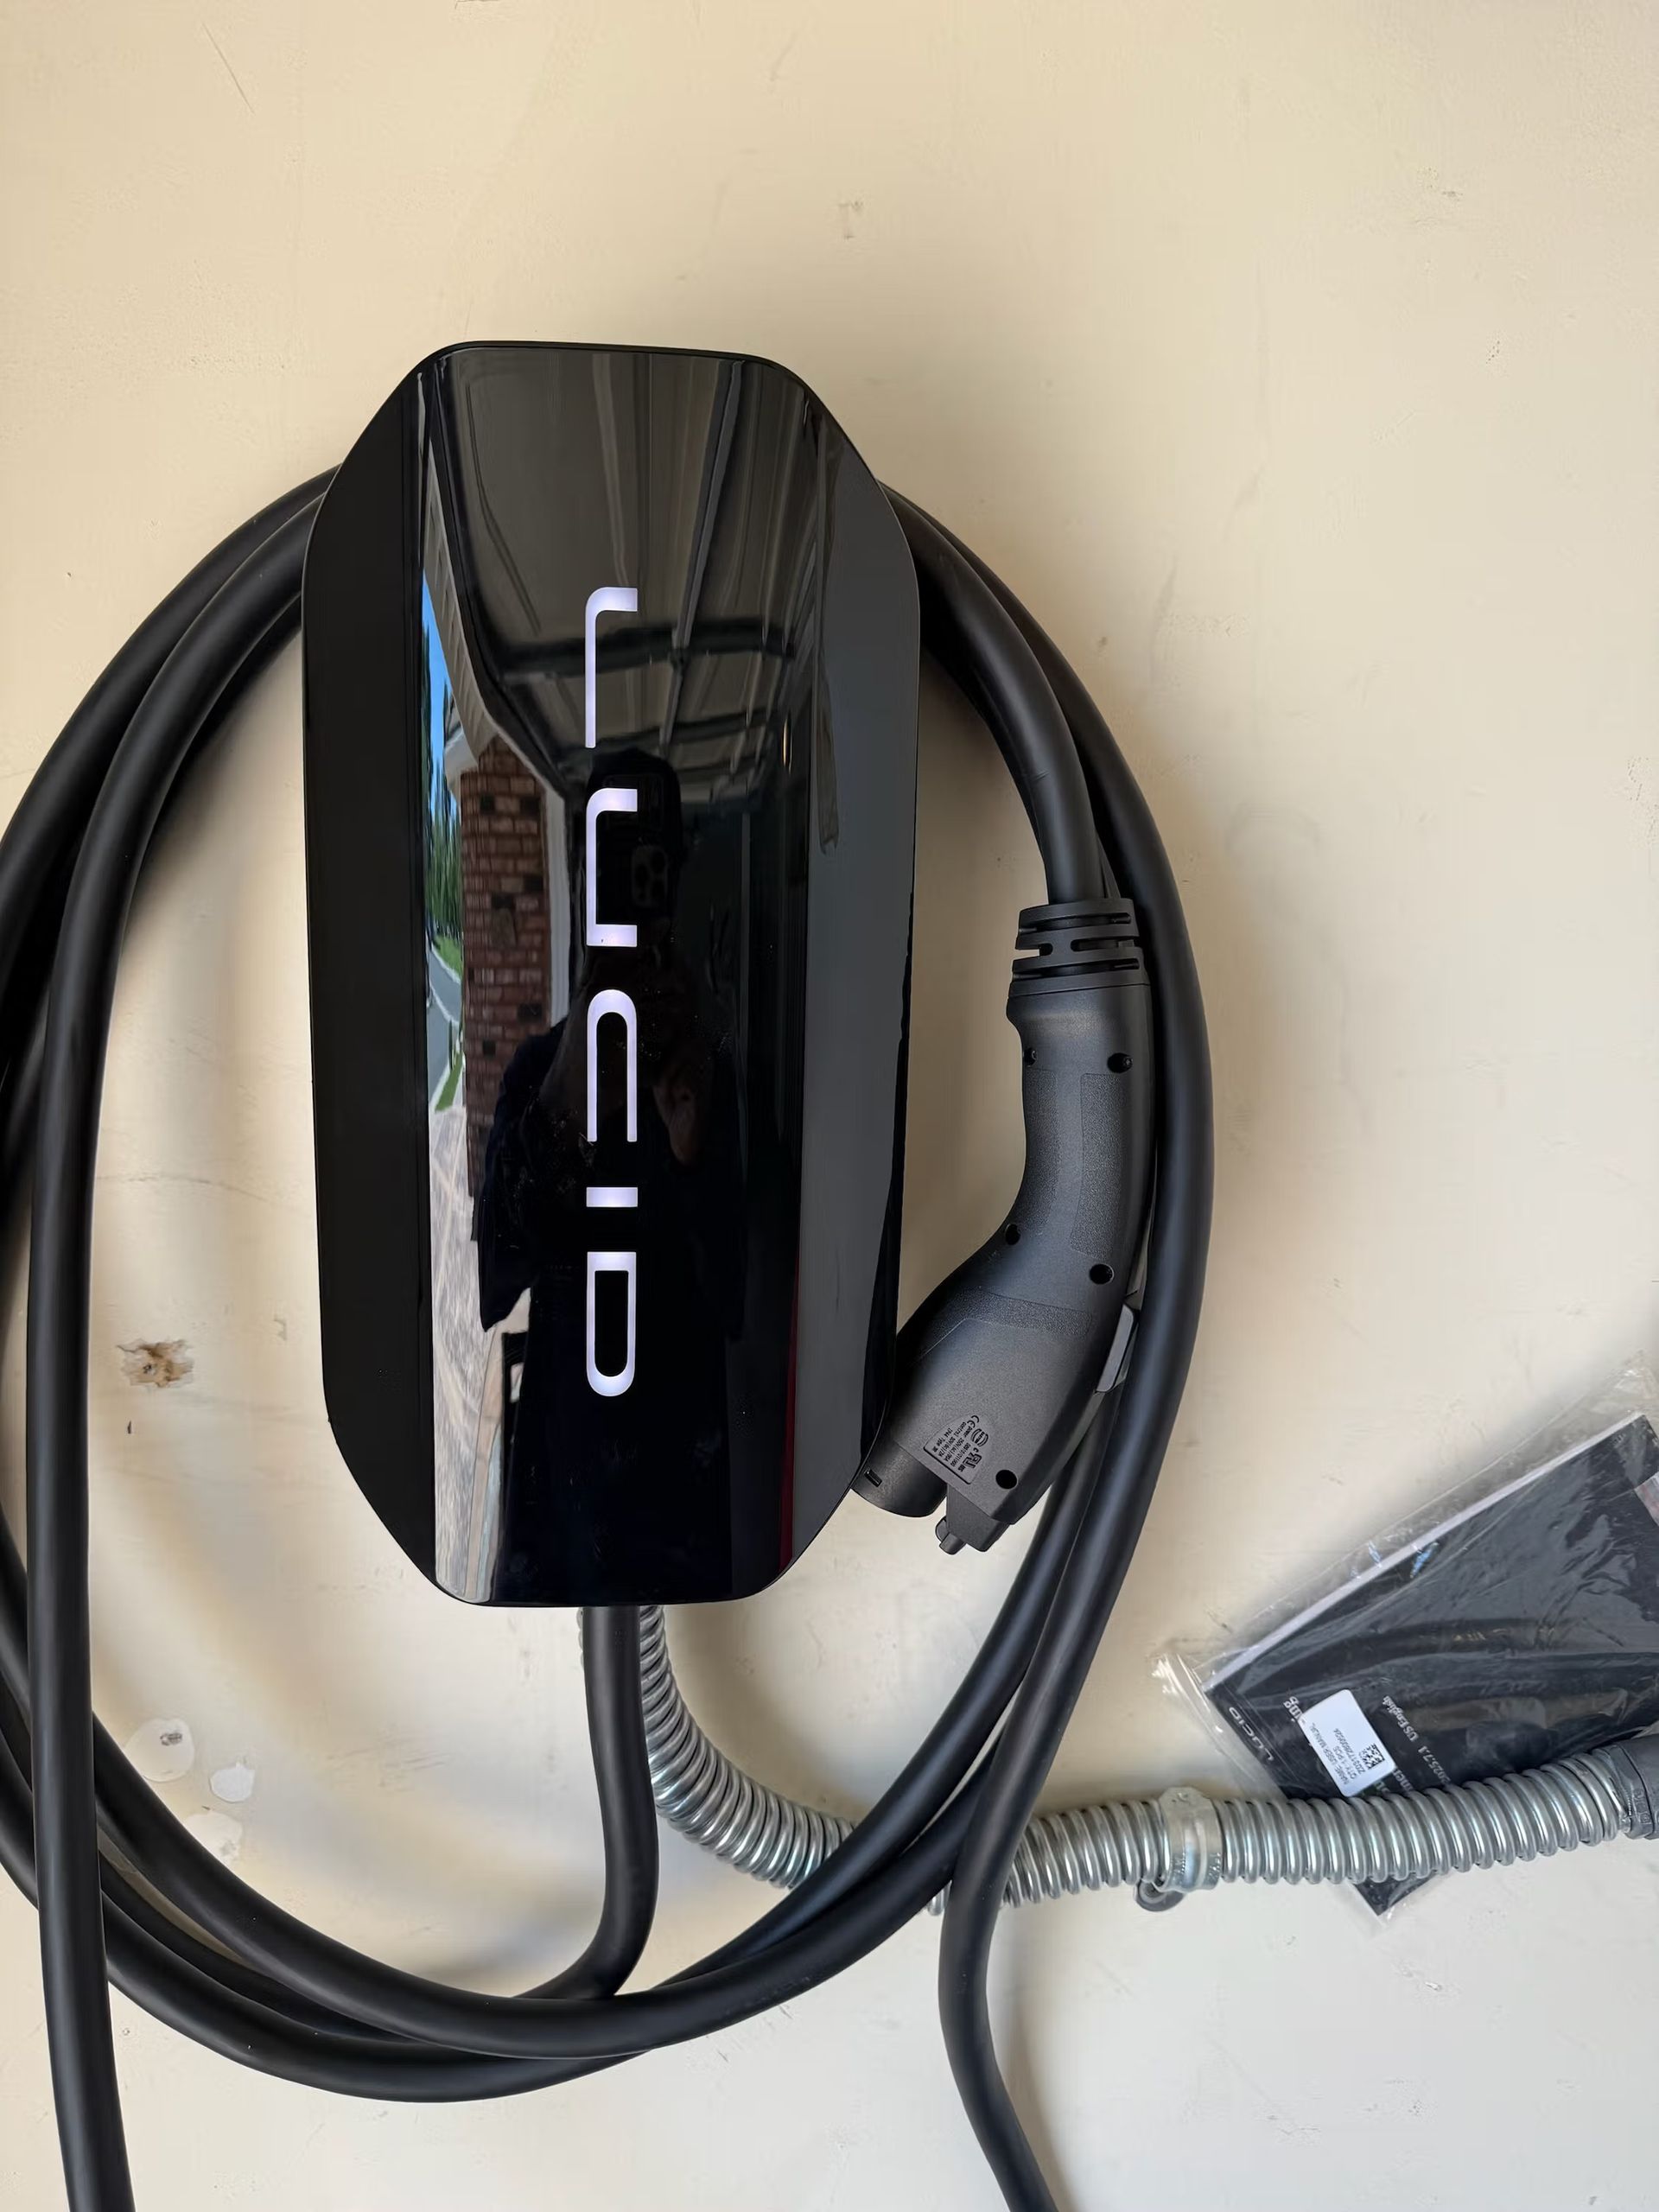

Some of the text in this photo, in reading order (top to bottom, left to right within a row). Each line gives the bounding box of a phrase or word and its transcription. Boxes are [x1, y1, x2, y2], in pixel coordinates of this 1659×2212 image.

[584, 587, 639, 1397] LUCID
[1382, 1695, 1410, 1728] English
[1229, 1707, 1274, 1761] LUCID
[1403, 1726, 1419, 1742] US
[1418, 1745, 1451, 1785] 2025.7.1
